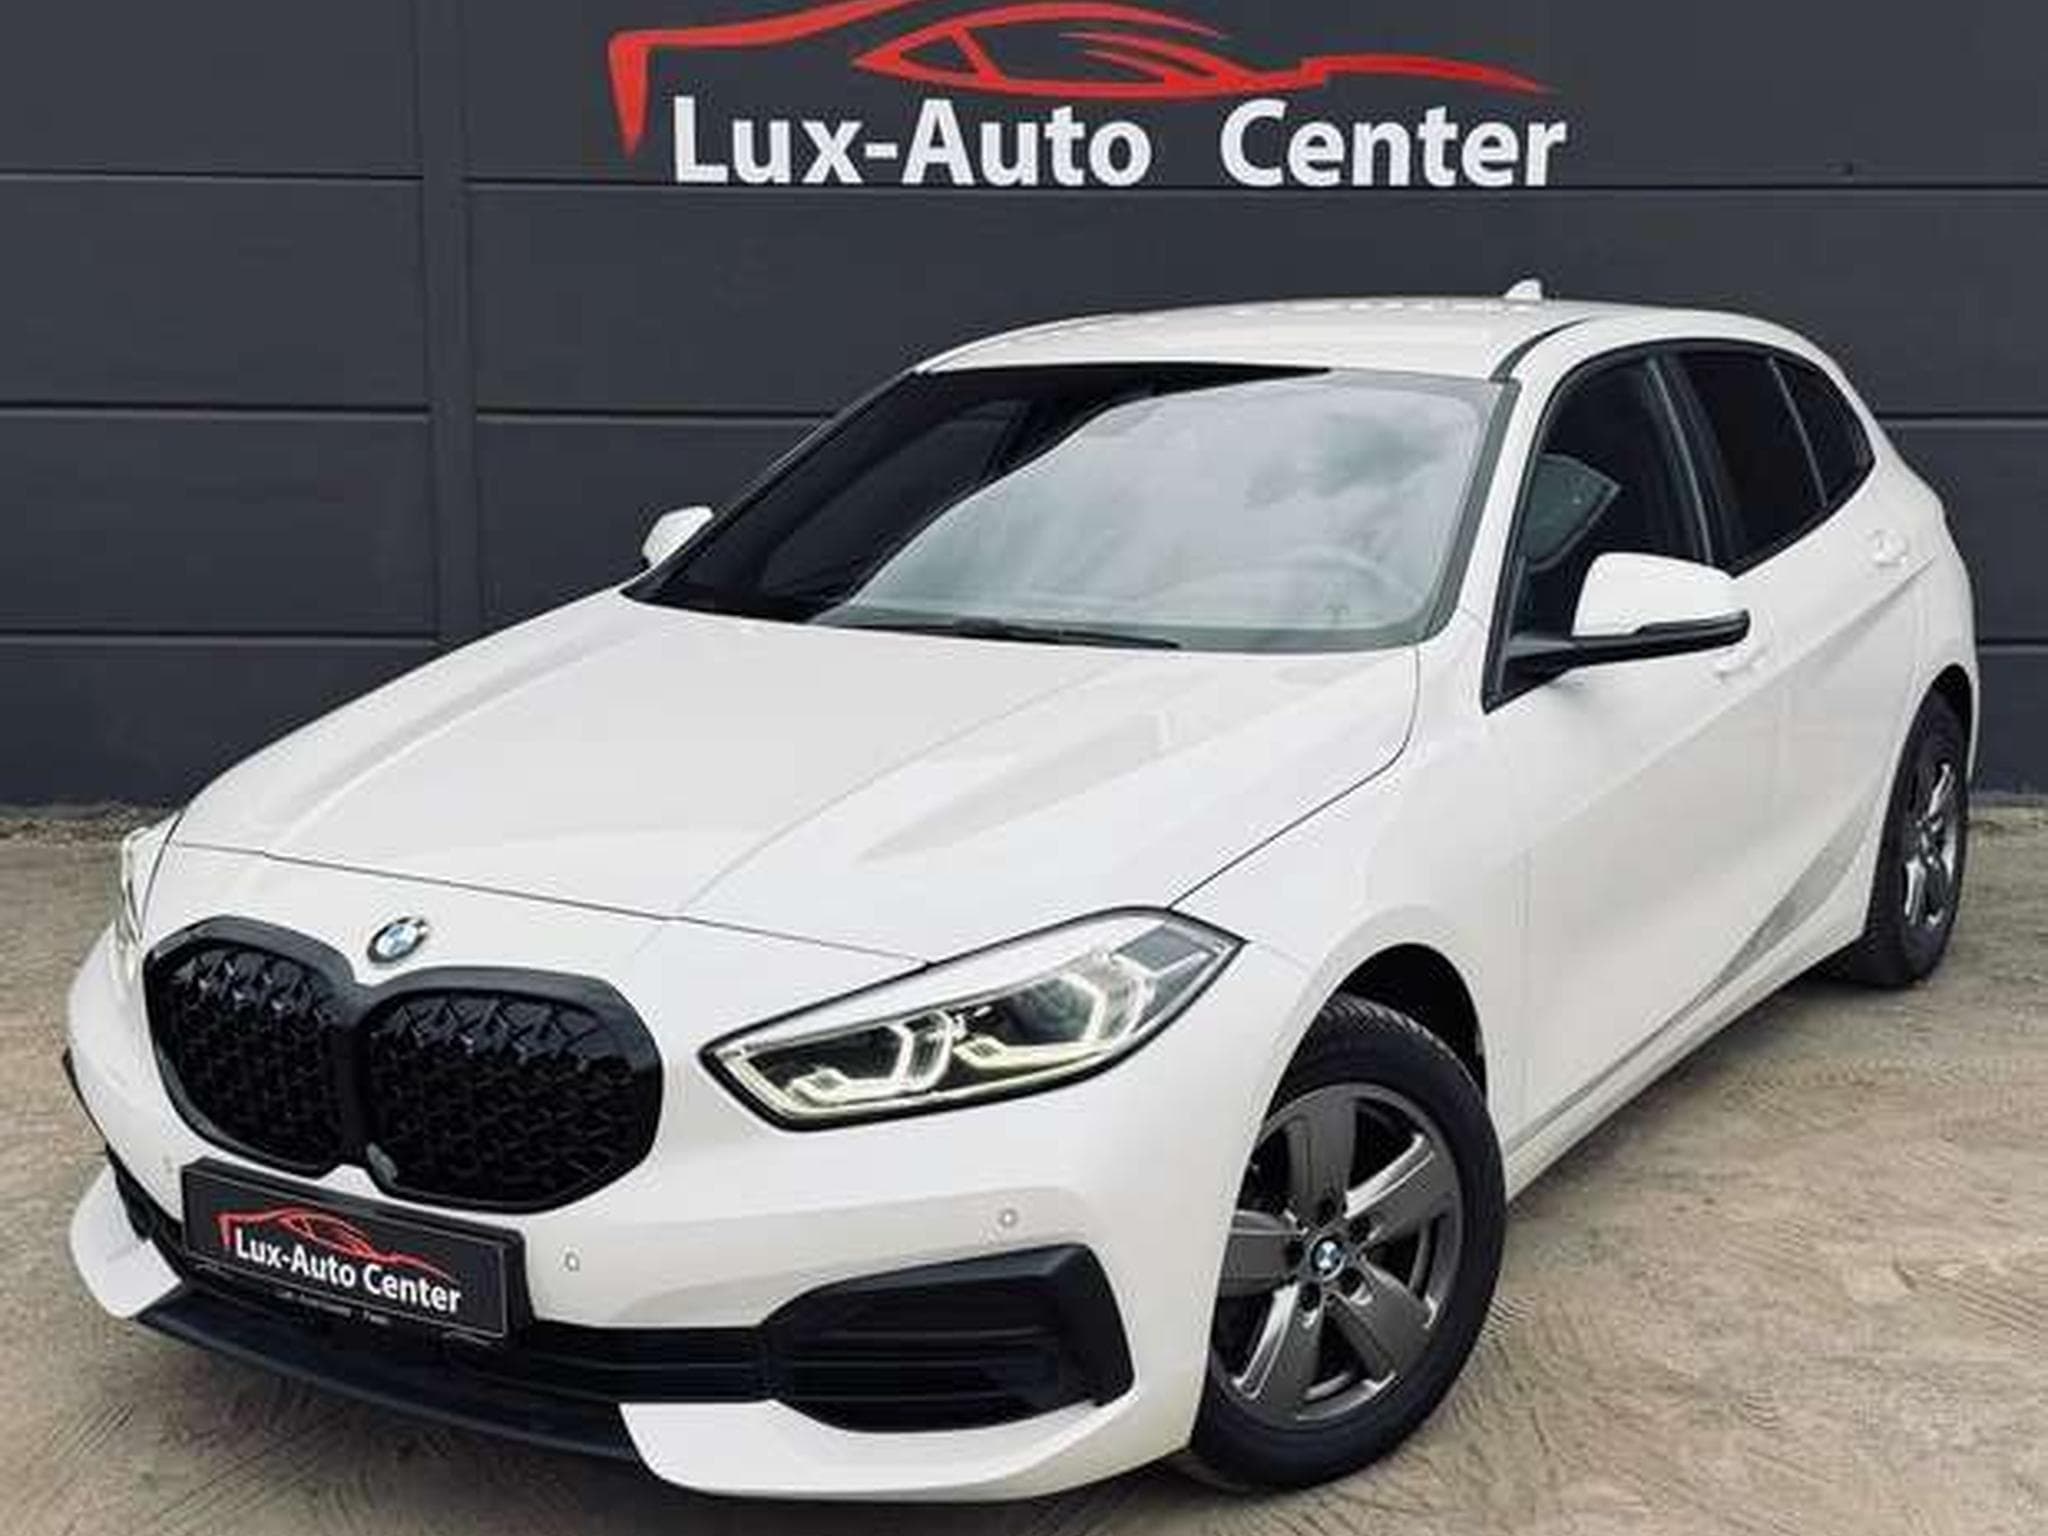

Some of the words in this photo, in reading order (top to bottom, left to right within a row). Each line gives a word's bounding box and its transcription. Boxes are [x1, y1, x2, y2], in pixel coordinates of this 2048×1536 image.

[673, 96, 1152, 187] Lux-Auto
[1219, 98, 1567, 188] Center
[235, 1226, 356, 1288] Lux-Auto
[362, 1263, 462, 1313] Center
